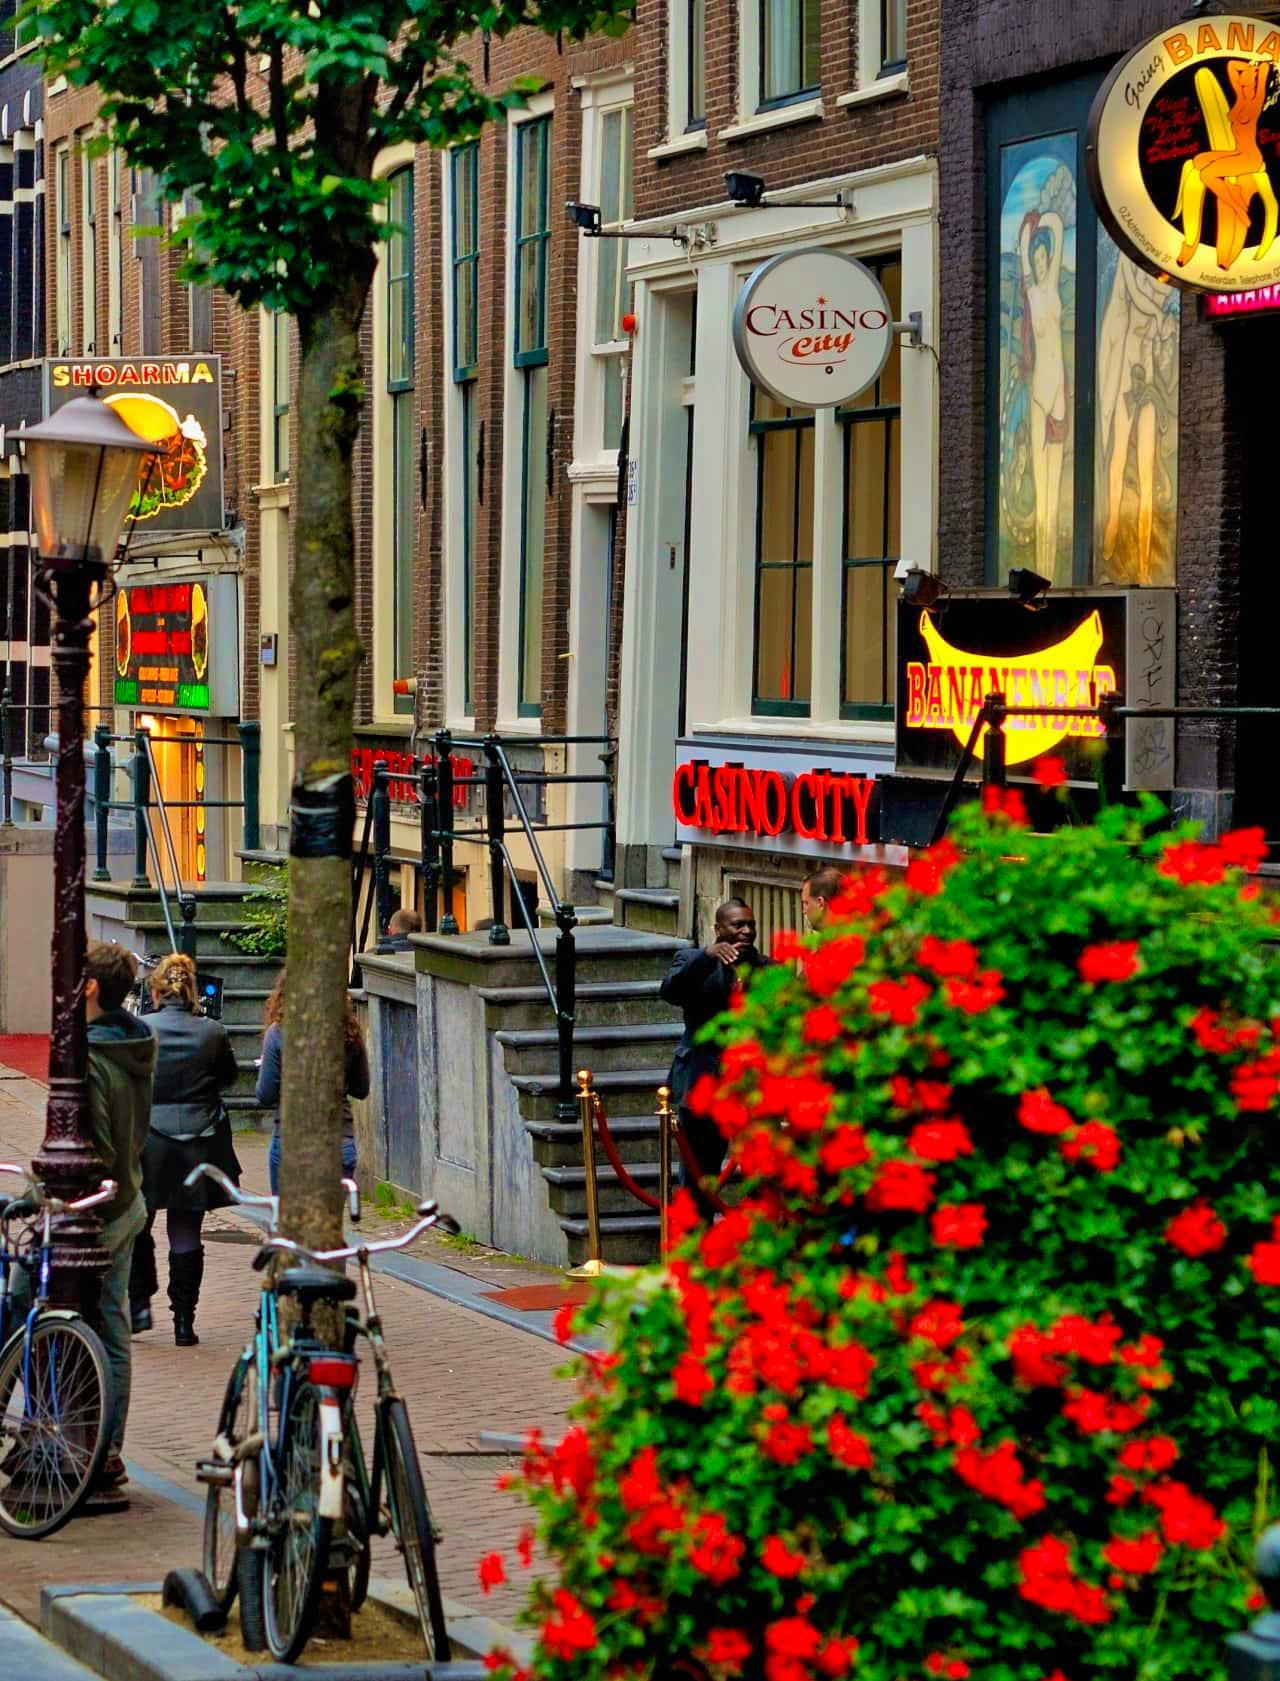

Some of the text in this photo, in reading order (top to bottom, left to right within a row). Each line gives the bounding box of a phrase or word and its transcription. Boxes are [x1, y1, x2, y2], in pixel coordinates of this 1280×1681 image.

[1124, 54, 1164, 110] Going
[746, 303, 888, 336] CASINO
[791, 332, 855, 357] City
[52, 362, 214, 386] SHOARMA
[673, 762, 877, 845] CASINO CITY
